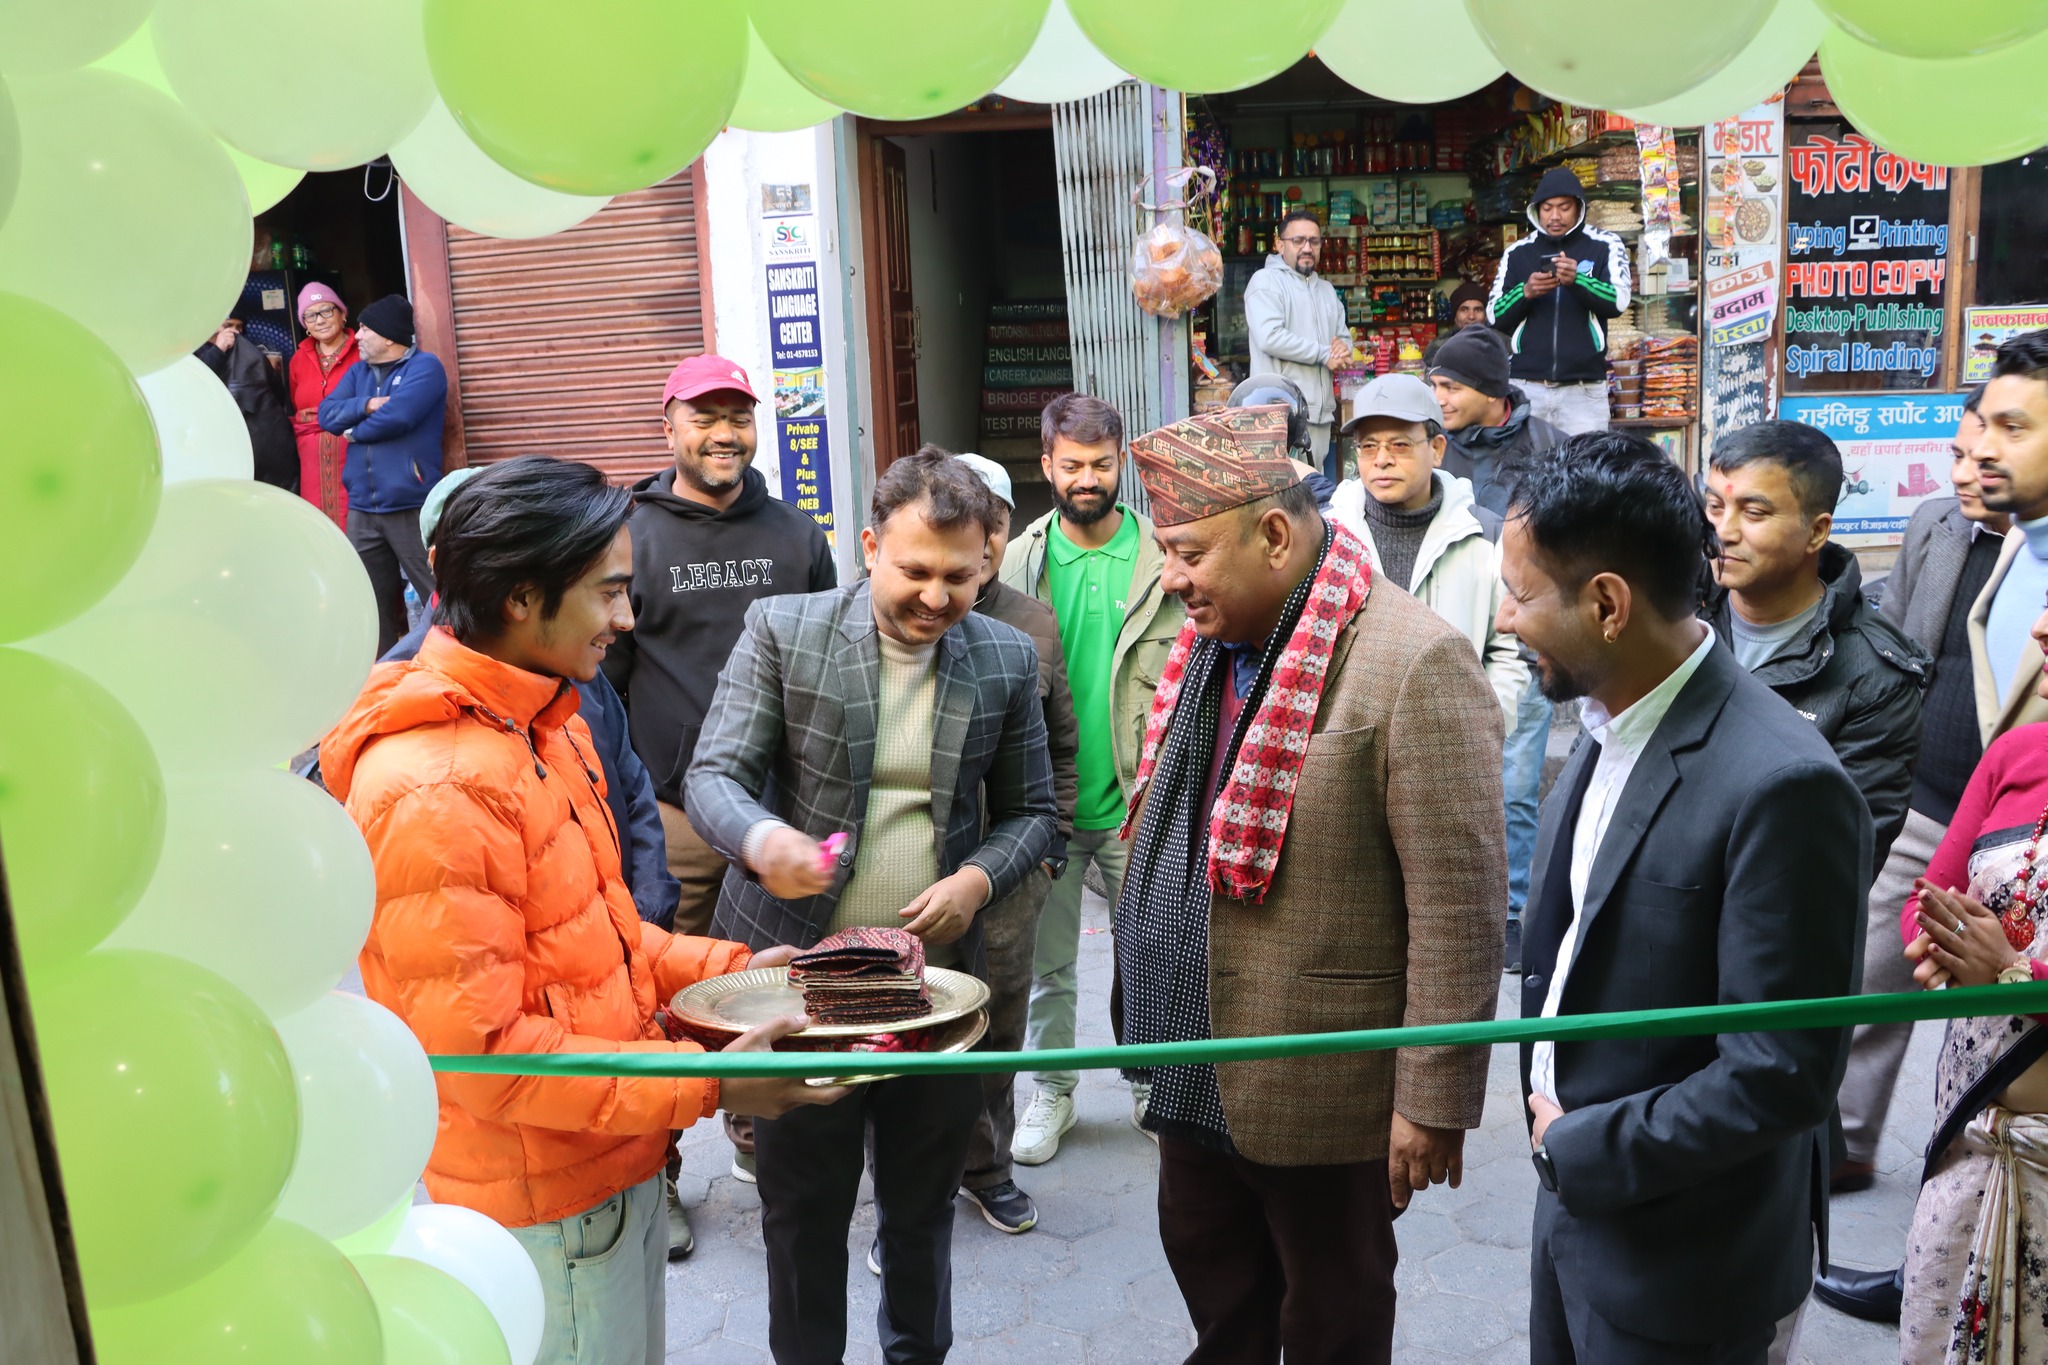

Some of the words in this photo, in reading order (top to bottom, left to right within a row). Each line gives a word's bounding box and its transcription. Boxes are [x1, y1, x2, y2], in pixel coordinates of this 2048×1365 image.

[1789, 133, 1873, 198] फोटो
[1787, 220, 1847, 256] Typing
[1879, 218, 1949, 256] Printing
[768, 266, 816, 291] SANSKRITI
[1786, 261, 1868, 298] PHOTO
[1871, 258, 1946, 295] COPY
[772, 294, 818, 318] LANGUAGE
[1713, 290, 1765, 319] बदाम
[1786, 302, 1945, 336] Desktop-Publishing
[780, 321, 813, 345] CENTER
[989, 347, 1034, 362] ENGLISH
[1786, 343, 1850, 378] Spiral
[1851, 341, 1937, 378] Binding
[989, 369, 1028, 381] CAREER
[988, 391, 1038, 405] BRIDGE
[786, 422, 820, 436] Private
[985, 417, 1015, 430] TEST
[790, 437, 818, 452] 8/SEE
[801, 453, 809, 465] &
[796, 468, 816, 481] Plus
[797, 498, 819, 510] (NEB
[670, 559, 773, 592] LEGACY
